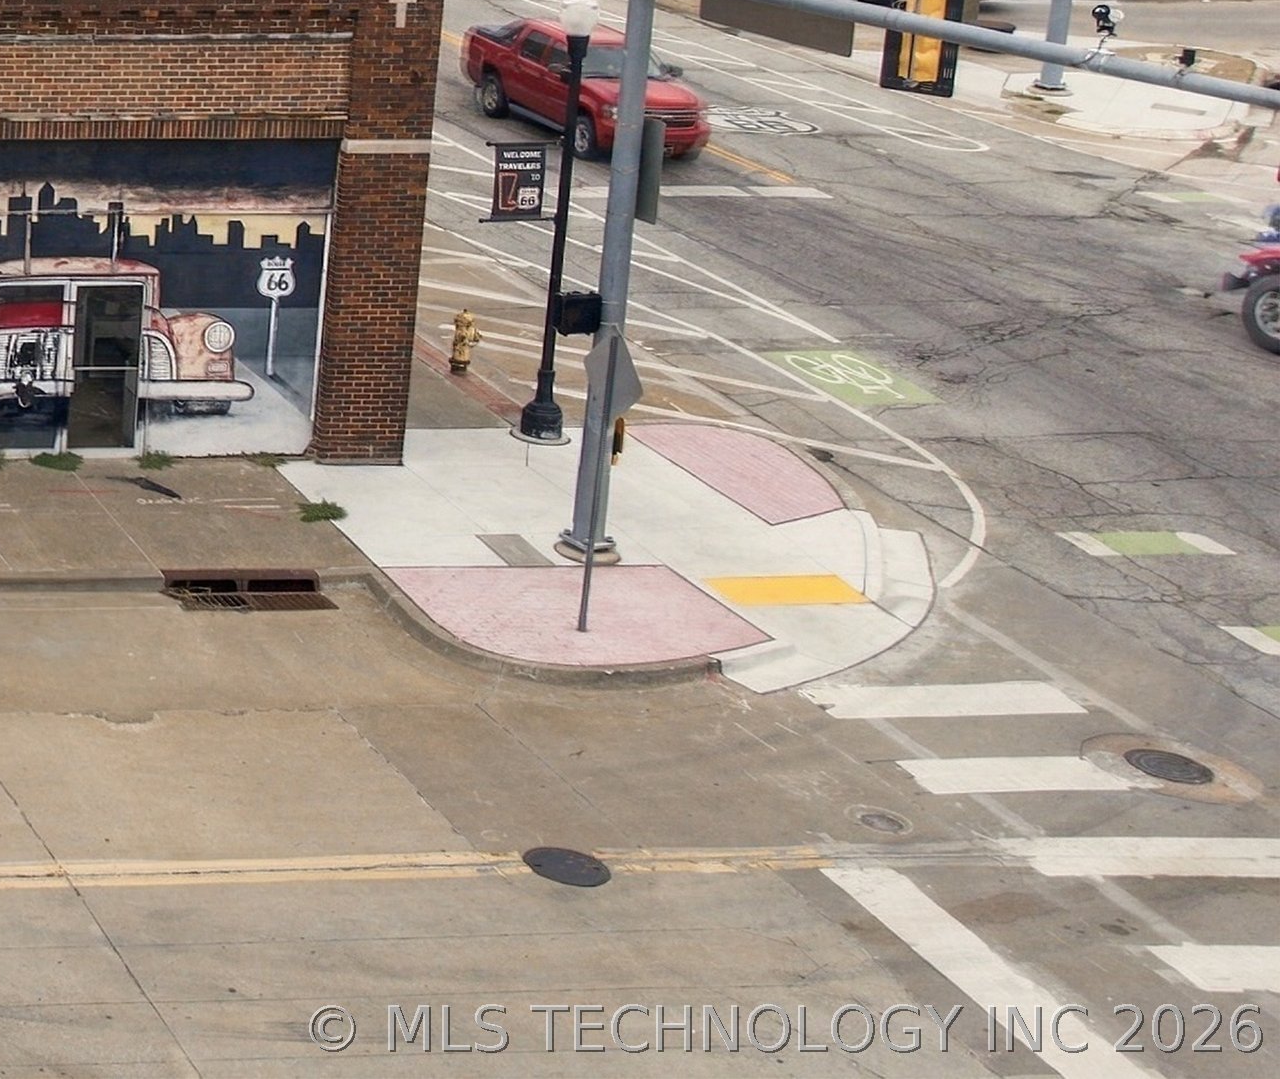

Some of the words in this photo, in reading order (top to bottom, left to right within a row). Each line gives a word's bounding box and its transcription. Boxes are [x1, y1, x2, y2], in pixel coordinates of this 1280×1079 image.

[499, 162, 541, 170] TRAVELERS
[520, 196, 535, 206] 66
[267, 273, 289, 291] 66
